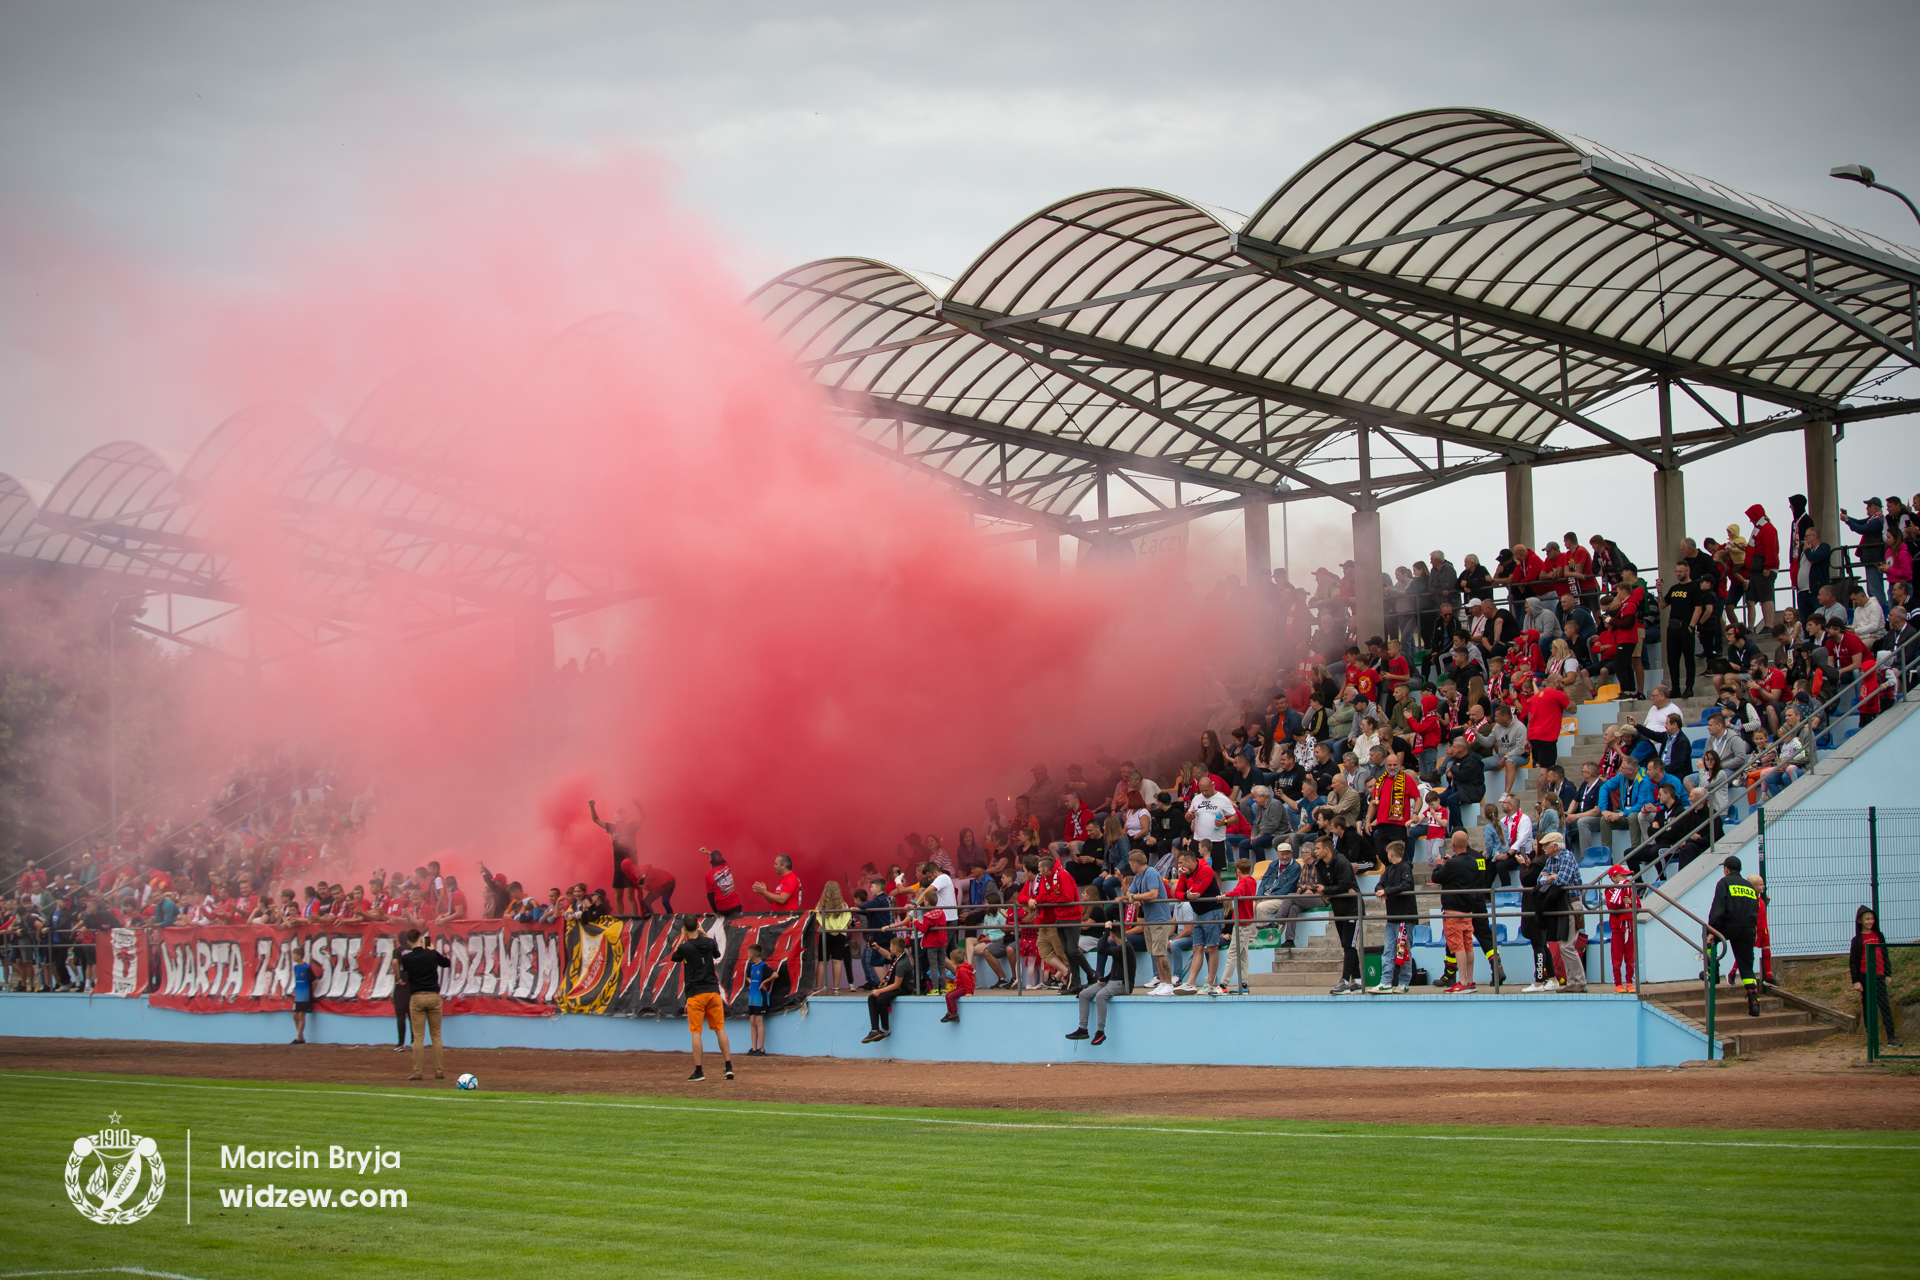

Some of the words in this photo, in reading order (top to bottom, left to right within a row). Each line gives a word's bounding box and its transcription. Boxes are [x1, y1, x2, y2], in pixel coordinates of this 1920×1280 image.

[160, 939, 244, 999] WARTA
[370, 937, 395, 999] Z
[1536, 952, 1544, 979] adidas
